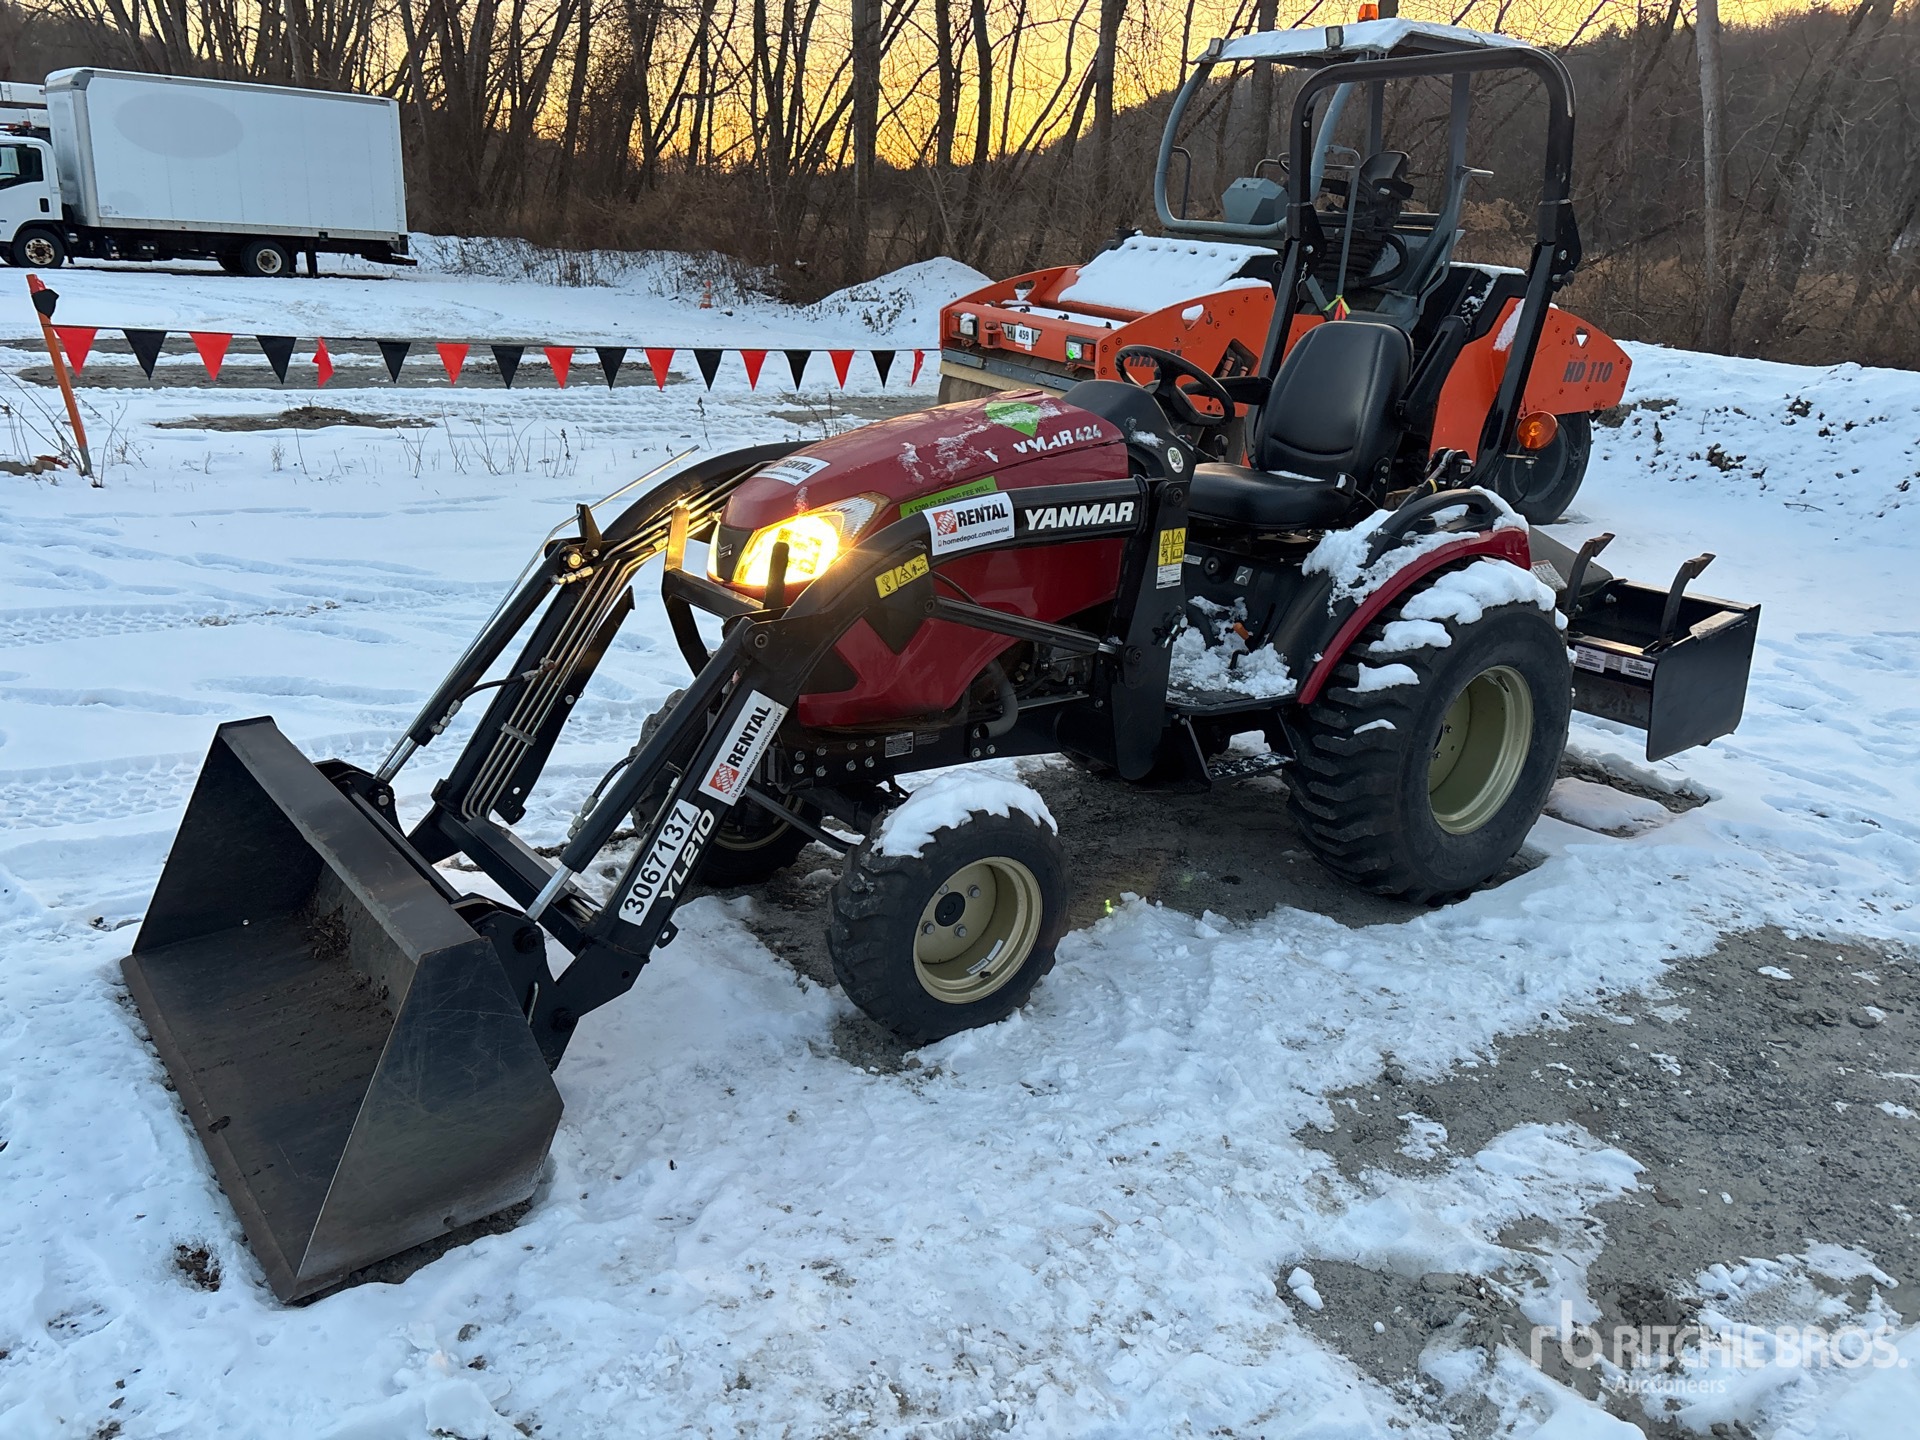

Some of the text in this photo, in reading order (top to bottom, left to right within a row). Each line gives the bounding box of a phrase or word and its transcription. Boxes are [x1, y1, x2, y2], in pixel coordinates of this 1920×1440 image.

[1018, 329, 1030, 341] 459
[1562, 361, 1613, 383] HD 110
[1075, 424, 1102, 442] 424
[962, 488, 975, 497] FEE
[975, 484, 990, 495] WILL
[956, 502, 1009, 528] RENTAL
[1024, 501, 1135, 531] YANMAR
[942, 525, 1010, 546] homedepot.com/rental
[726, 706, 772, 768] RENTAL
[734, 712, 783, 793] homedepot.com/rental
[624, 806, 691, 915] 3067137
[659, 808, 715, 900] YL210
